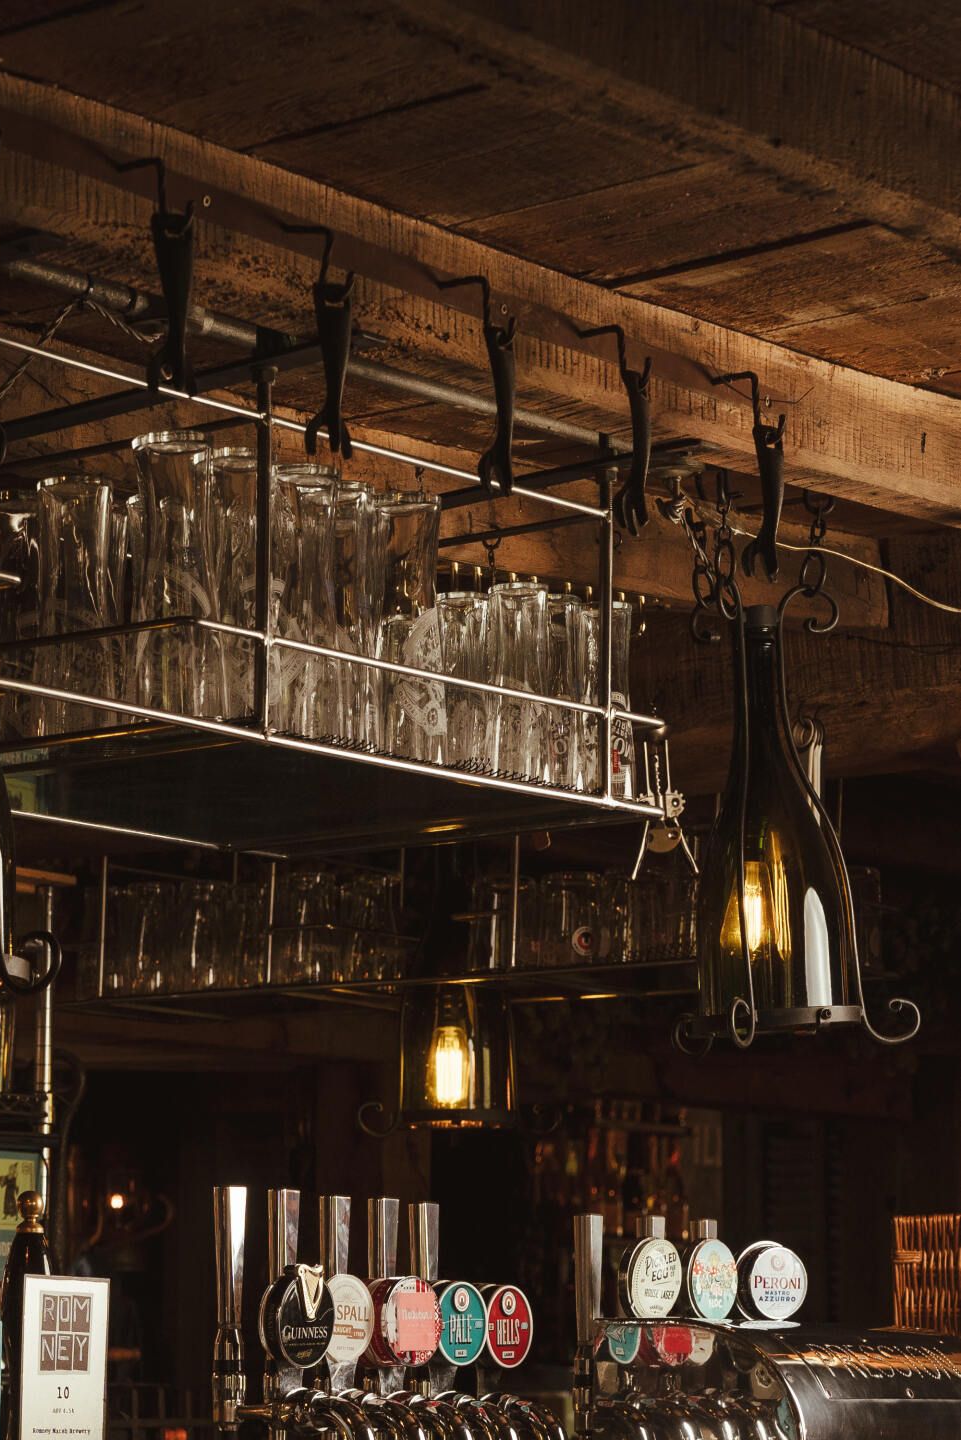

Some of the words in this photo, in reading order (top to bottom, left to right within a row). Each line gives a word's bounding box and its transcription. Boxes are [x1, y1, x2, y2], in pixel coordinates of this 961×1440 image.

[753, 1275, 801, 1290] PERONI
[336, 1304, 369, 1322] SPALL
[283, 1325, 328, 1341] GUINNESS
[449, 1315, 473, 1345] PALE
[496, 1319, 520, 1346] HELLS
[57, 1386, 70, 1400] 10
